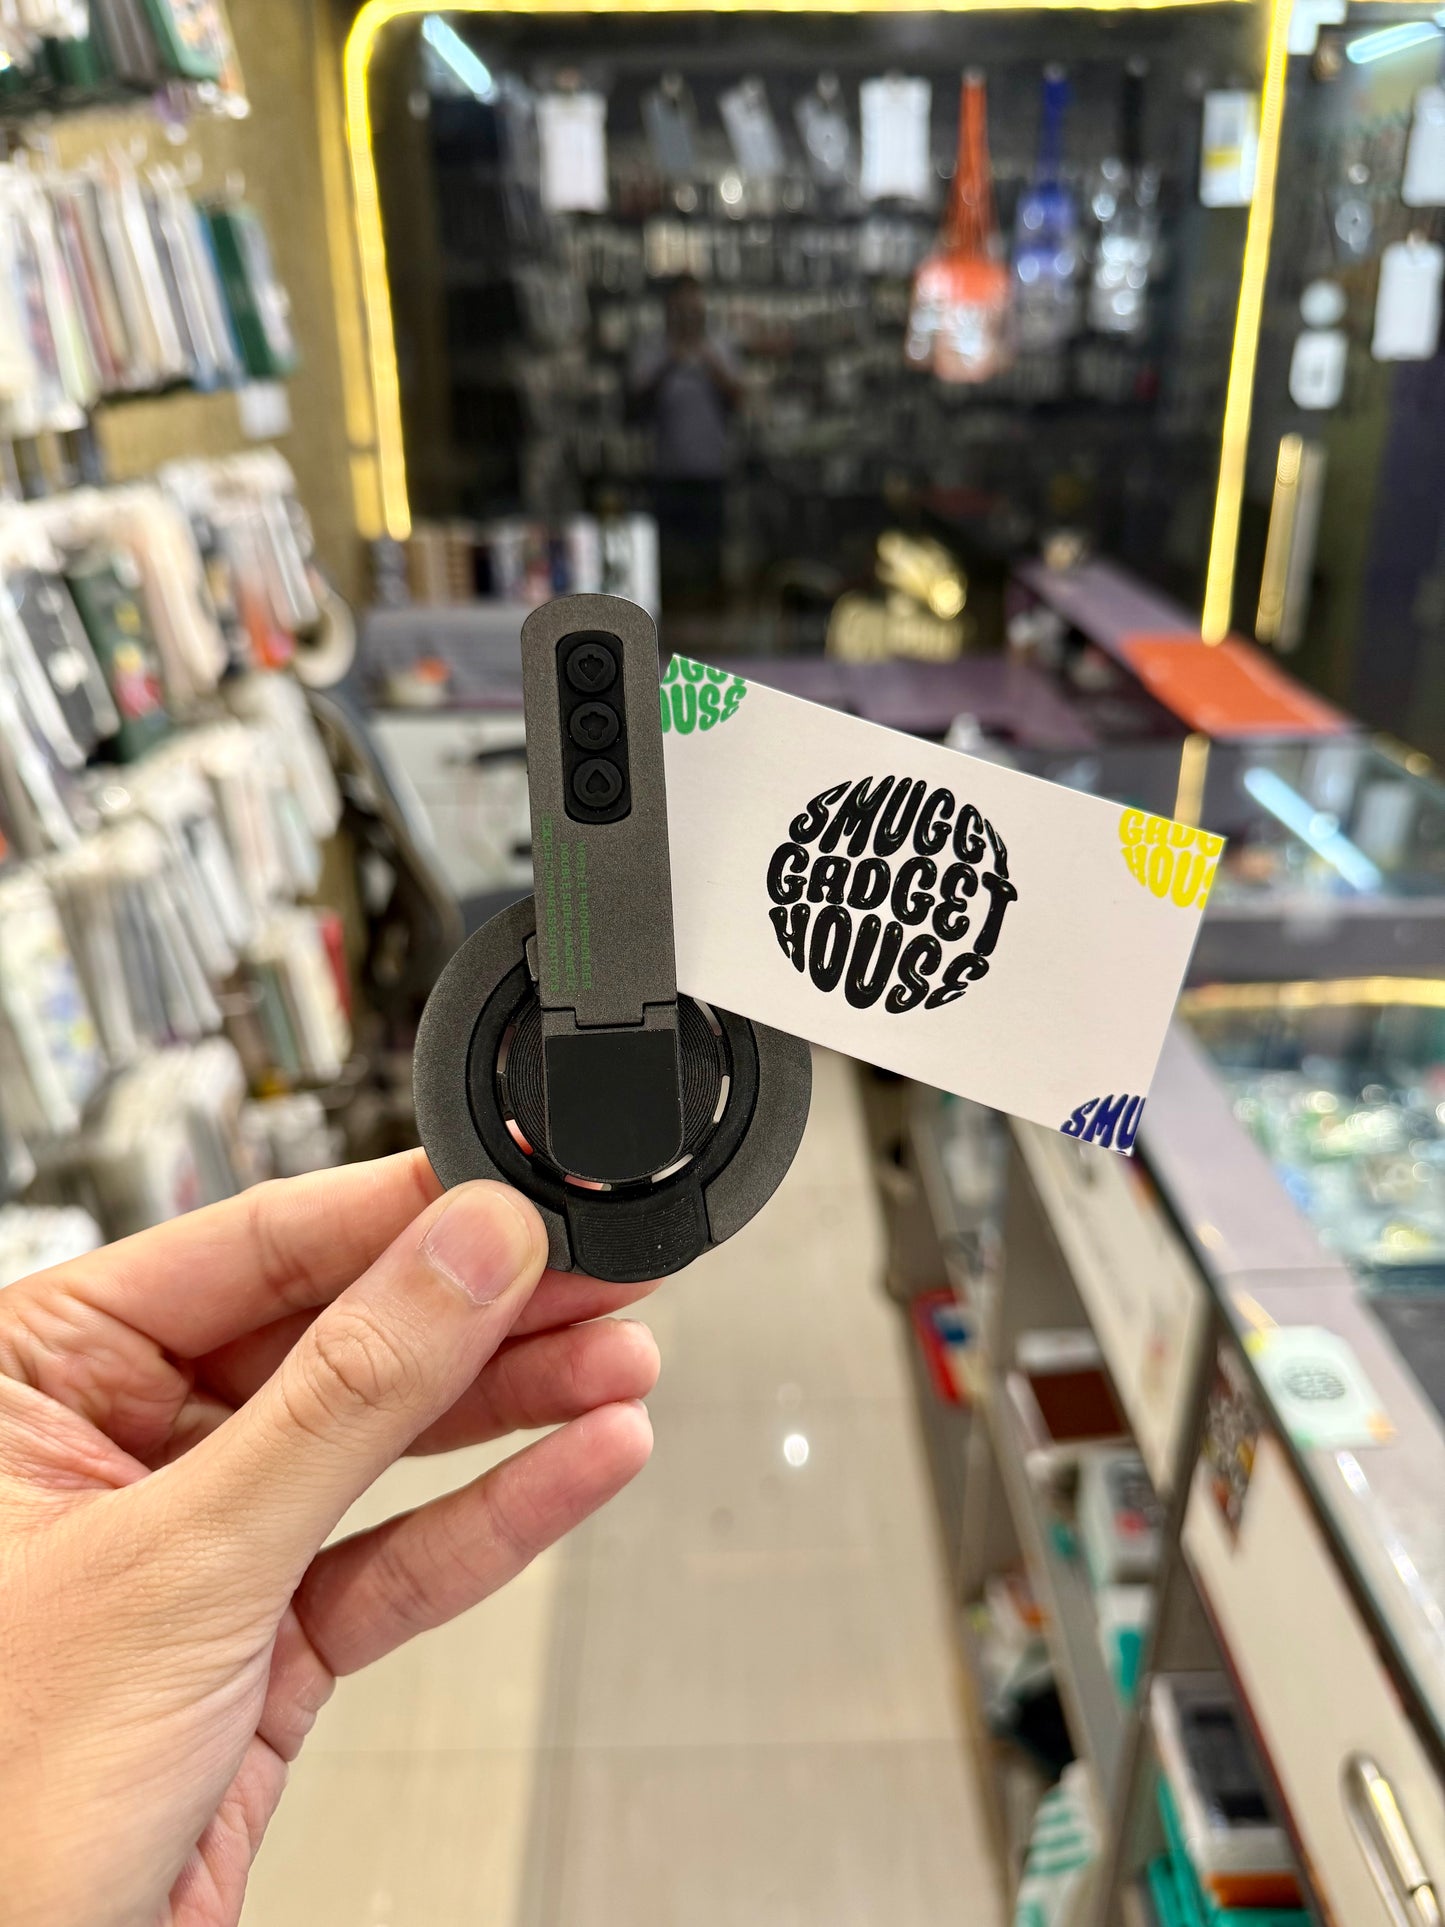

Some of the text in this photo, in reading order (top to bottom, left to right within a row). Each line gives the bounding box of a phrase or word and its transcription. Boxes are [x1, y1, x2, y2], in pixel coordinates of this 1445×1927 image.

[788, 775, 1009, 880] SMUGGY
[766, 842, 1018, 956] GADGET
[769, 902, 990, 1014] HOUSE
